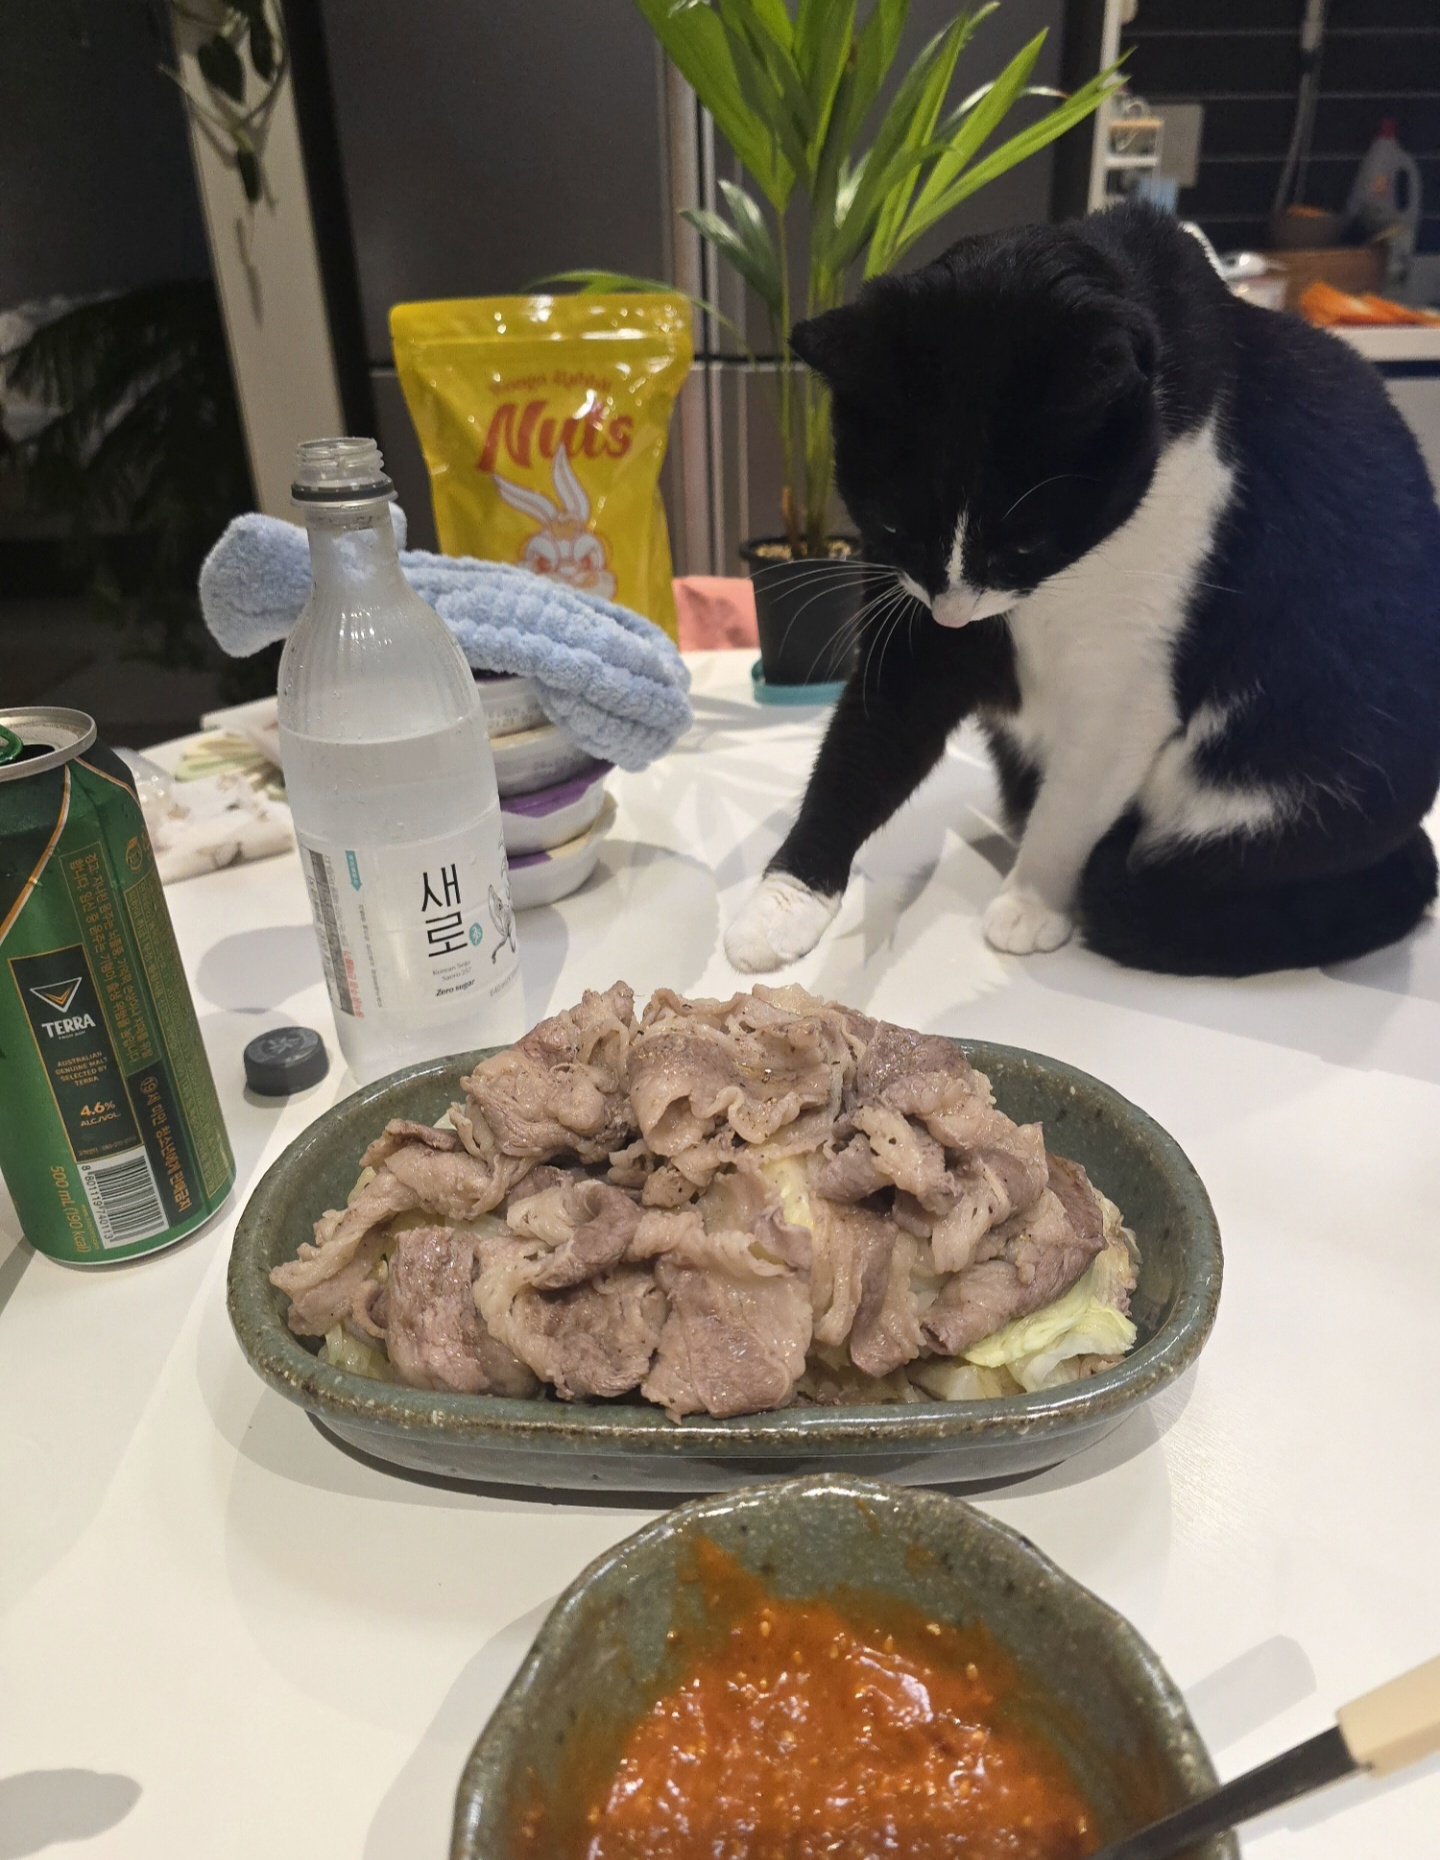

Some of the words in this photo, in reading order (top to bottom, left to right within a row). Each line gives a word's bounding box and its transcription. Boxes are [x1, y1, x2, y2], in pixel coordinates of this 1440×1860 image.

[477, 400, 633, 473] Nuts
[421, 863, 468, 957] 새로
[436, 988, 455, 997] Zero
[455, 979, 476, 992] sugar
[41, 1013, 96, 1039] TERRA
[55, 1062, 88, 1076] GENUINE
[89, 1056, 108, 1069] MALT
[57, 1051, 103, 1068] AUSTRALIAN
[60, 1069, 97, 1082] SELECTED
[97, 1065, 108, 1074] BY
[74, 1075, 99, 1087] TERRA
[80, 1101, 116, 1117] 4.6%
[151, 1103, 168, 1126] 미만
[156, 1125, 181, 1175] 청소년에게
[50, 1165, 70, 1188] 500
[63, 1207, 83, 1230] (190
[169, 1170, 192, 1212] 판매금지
